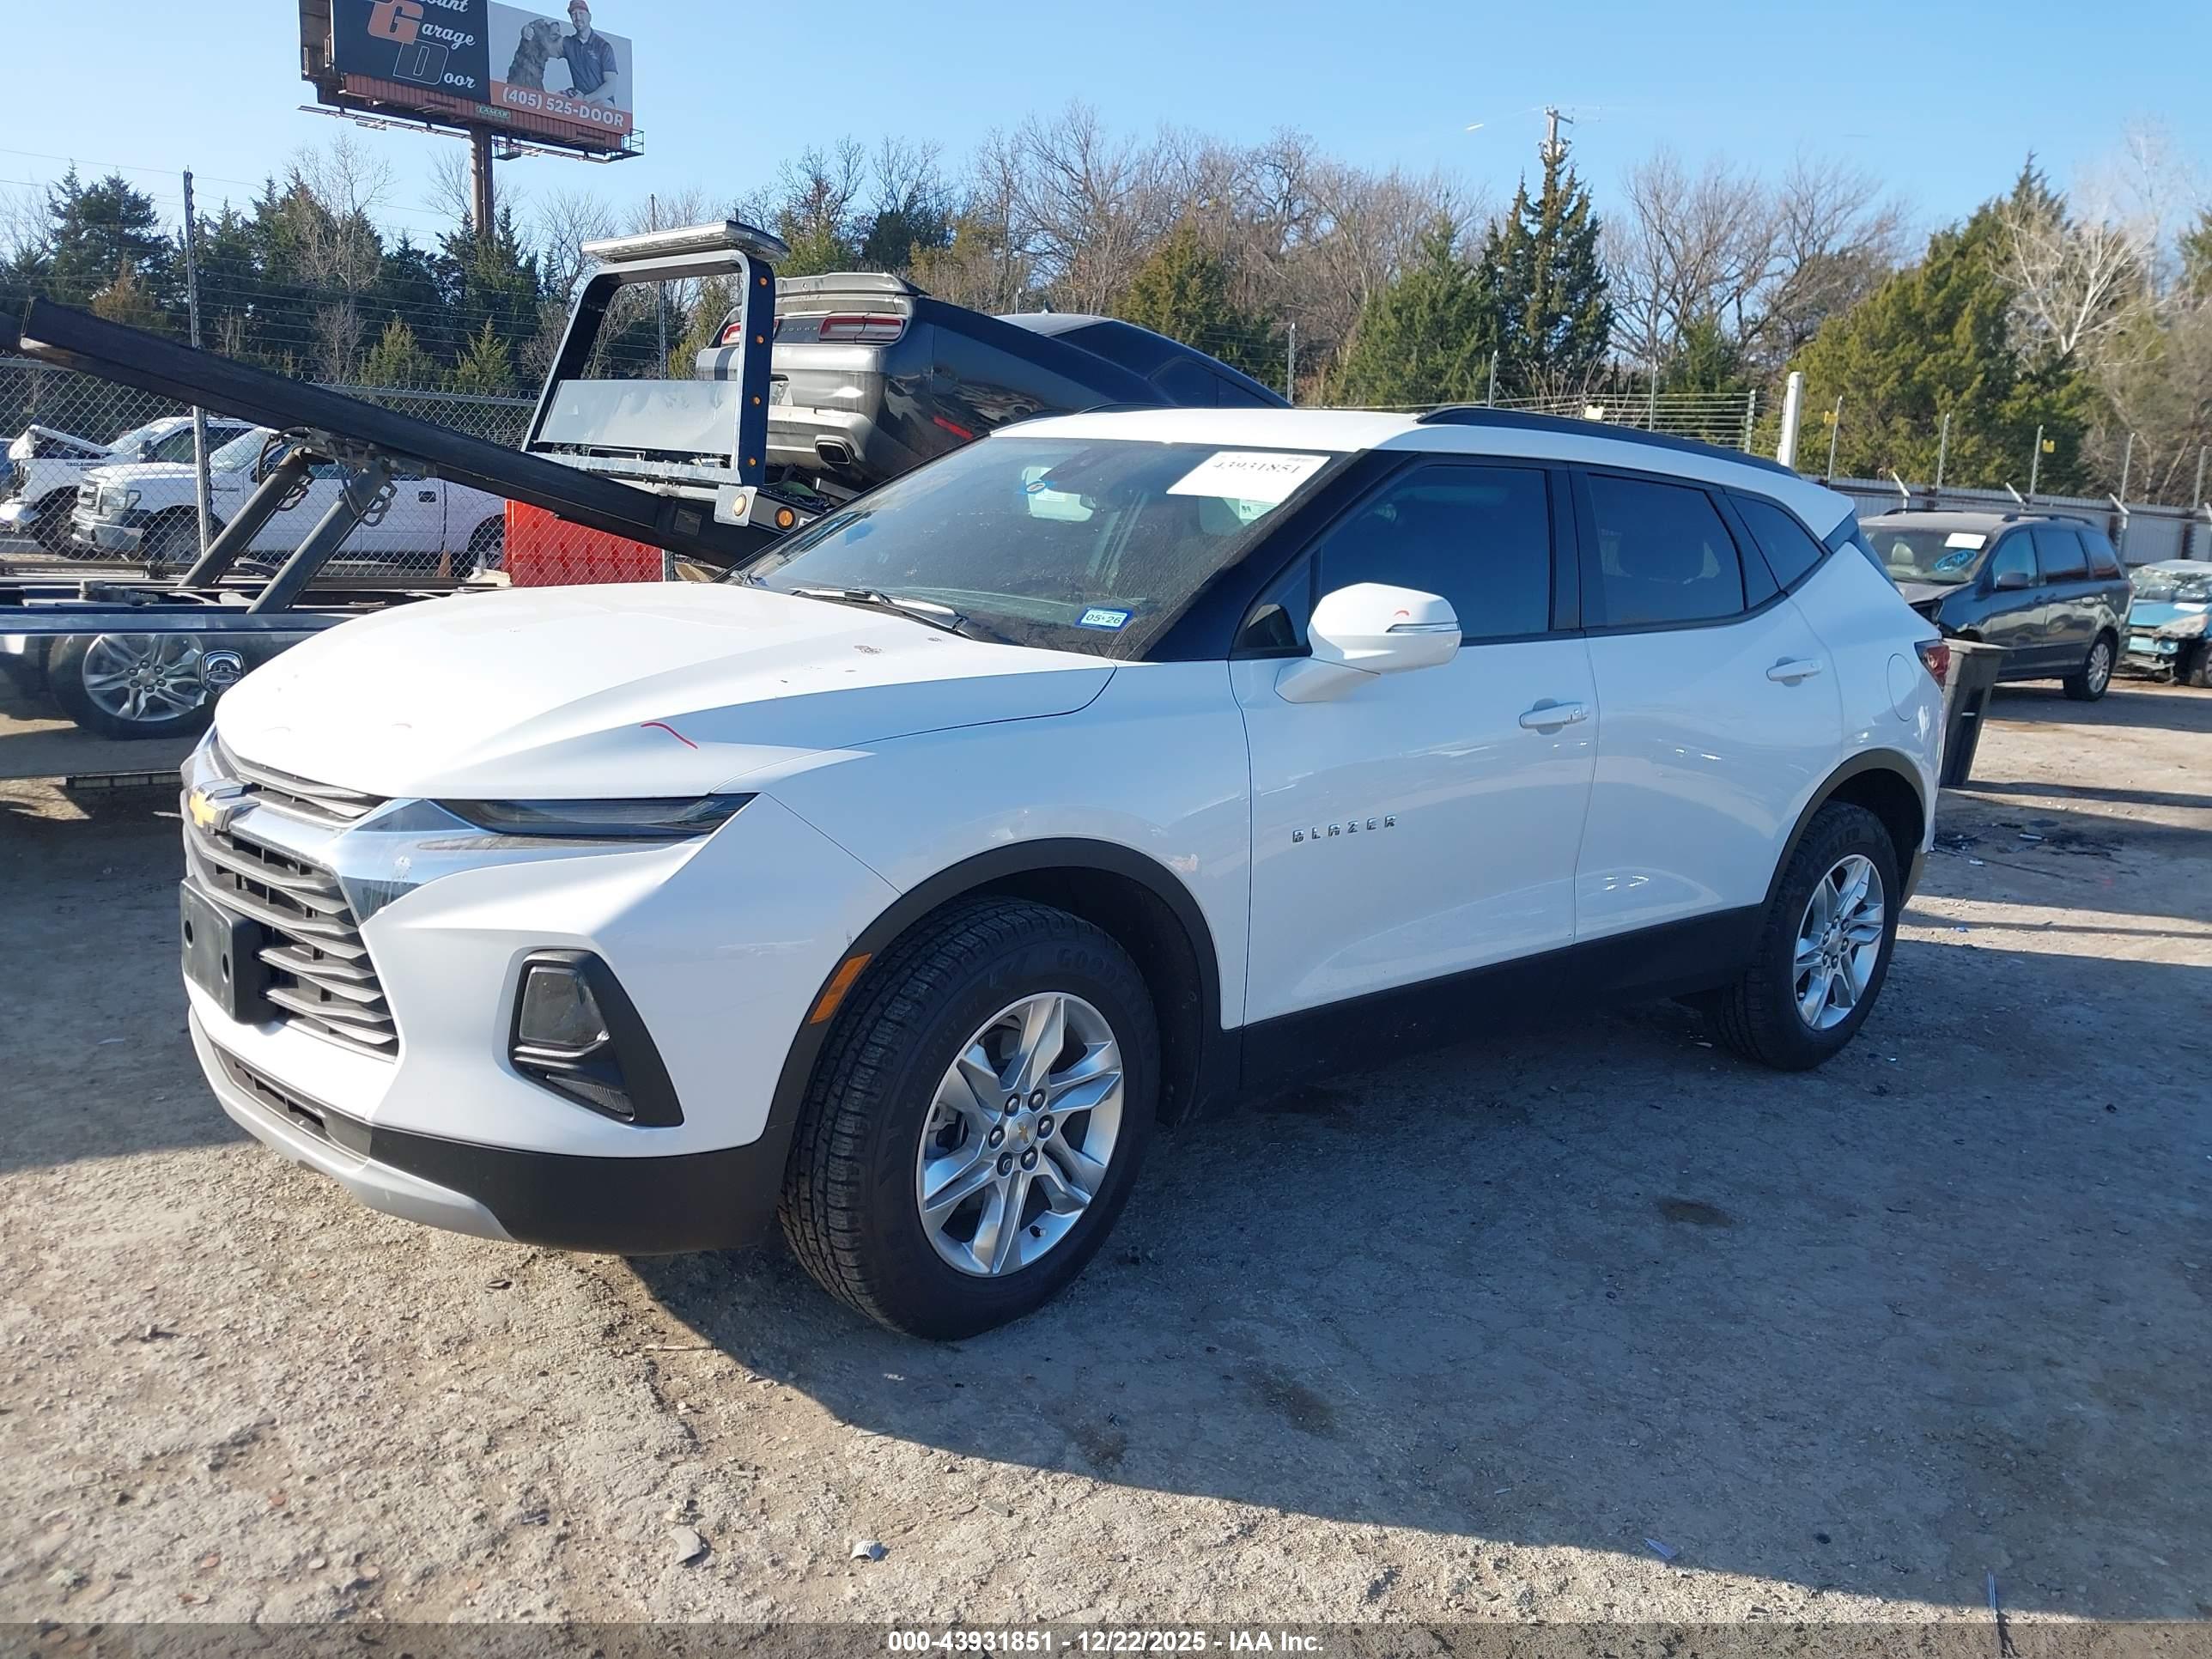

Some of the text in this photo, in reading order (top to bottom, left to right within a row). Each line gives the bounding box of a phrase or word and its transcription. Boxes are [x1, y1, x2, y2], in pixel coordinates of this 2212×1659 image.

[392, 39, 476, 88] Door
[502, 87, 624, 127] (405) 525-DOOR
[1292, 815, 1397, 843] BLAZER
